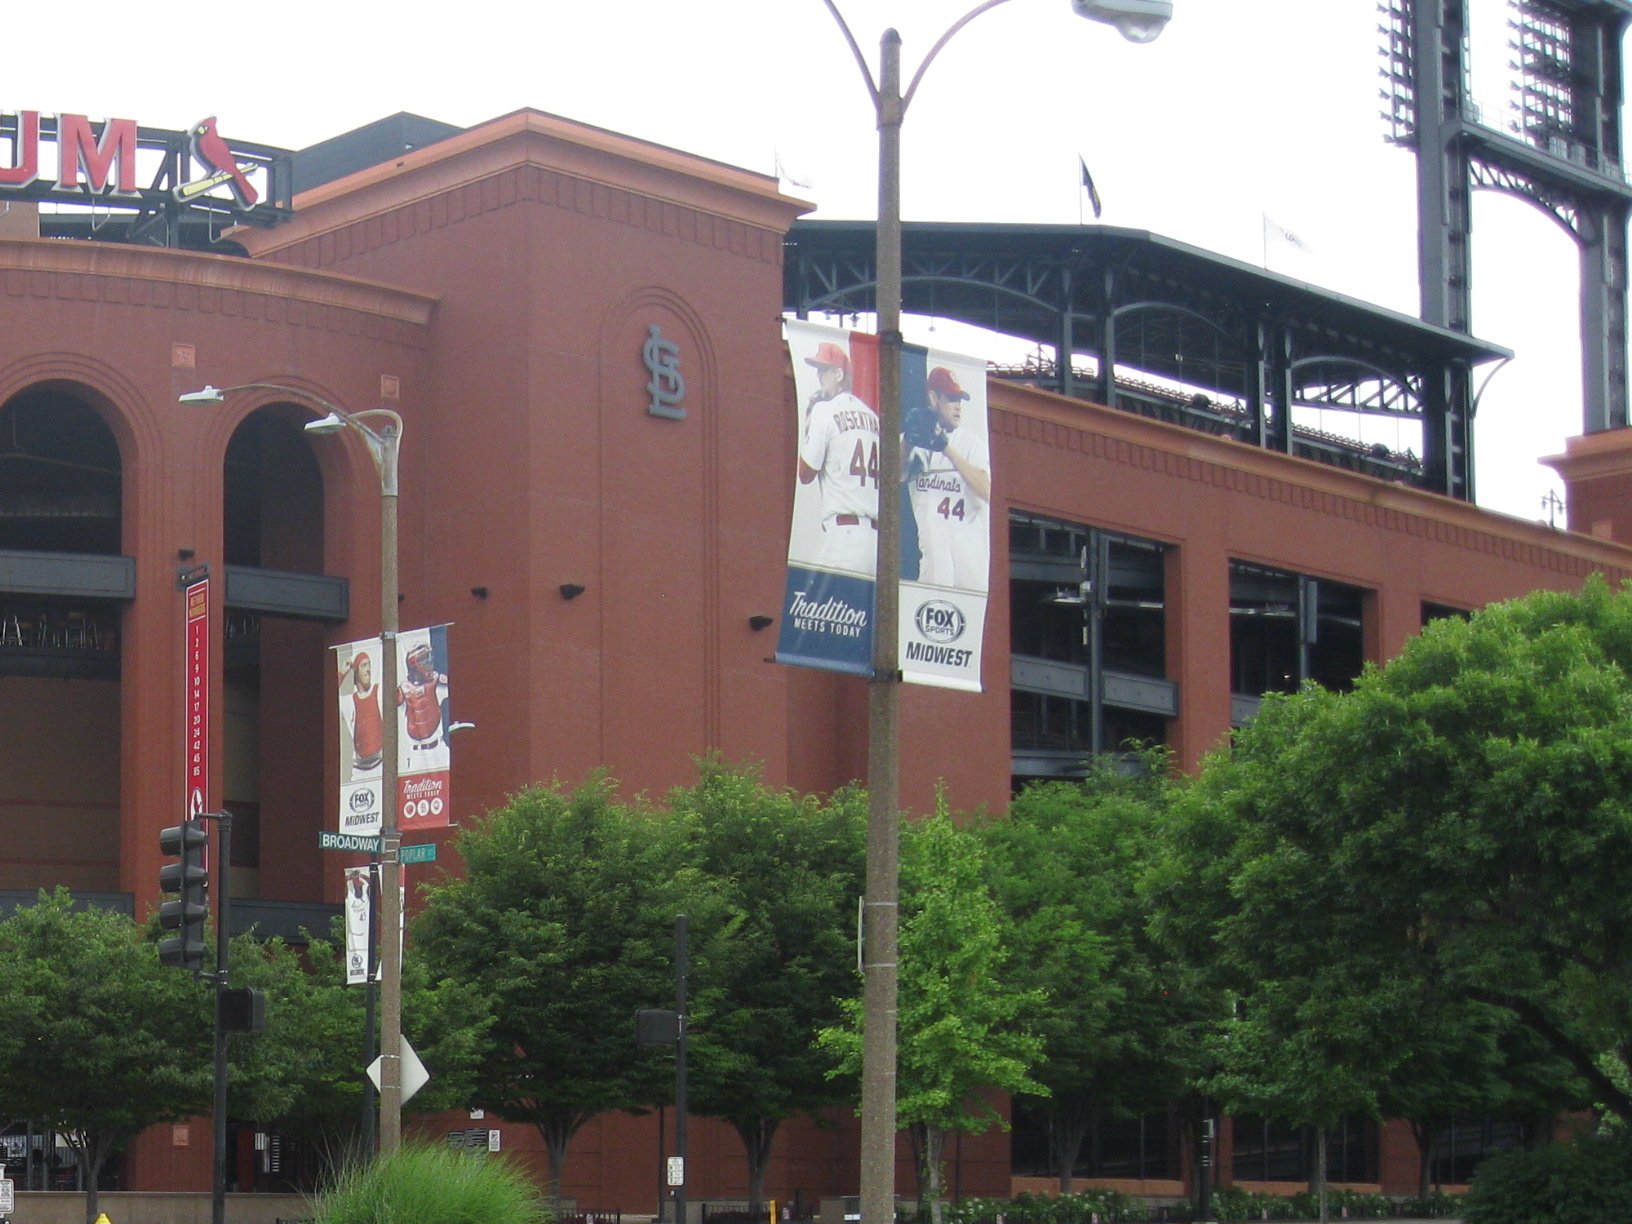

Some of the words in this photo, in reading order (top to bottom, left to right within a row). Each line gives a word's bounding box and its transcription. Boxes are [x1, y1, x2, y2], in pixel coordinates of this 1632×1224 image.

[849, 438, 880, 490] 44
[915, 474, 962, 493] Cardinals
[936, 496, 966, 521] 44
[789, 591, 868, 628] Tradition
[925, 607, 956, 628] FOX
[793, 617, 826, 633] MEETS
[829, 622, 862, 638] TODAY
[925, 623, 955, 636] SPORTS
[905, 641, 974, 668] MIDWEST
[402, 777, 443, 795] Tradition
[354, 792, 370, 805] FOX
[344, 811, 380, 827] MIDWEST
[322, 833, 380, 852] BROADWAY
[400, 847, 426, 862] POPLAR
